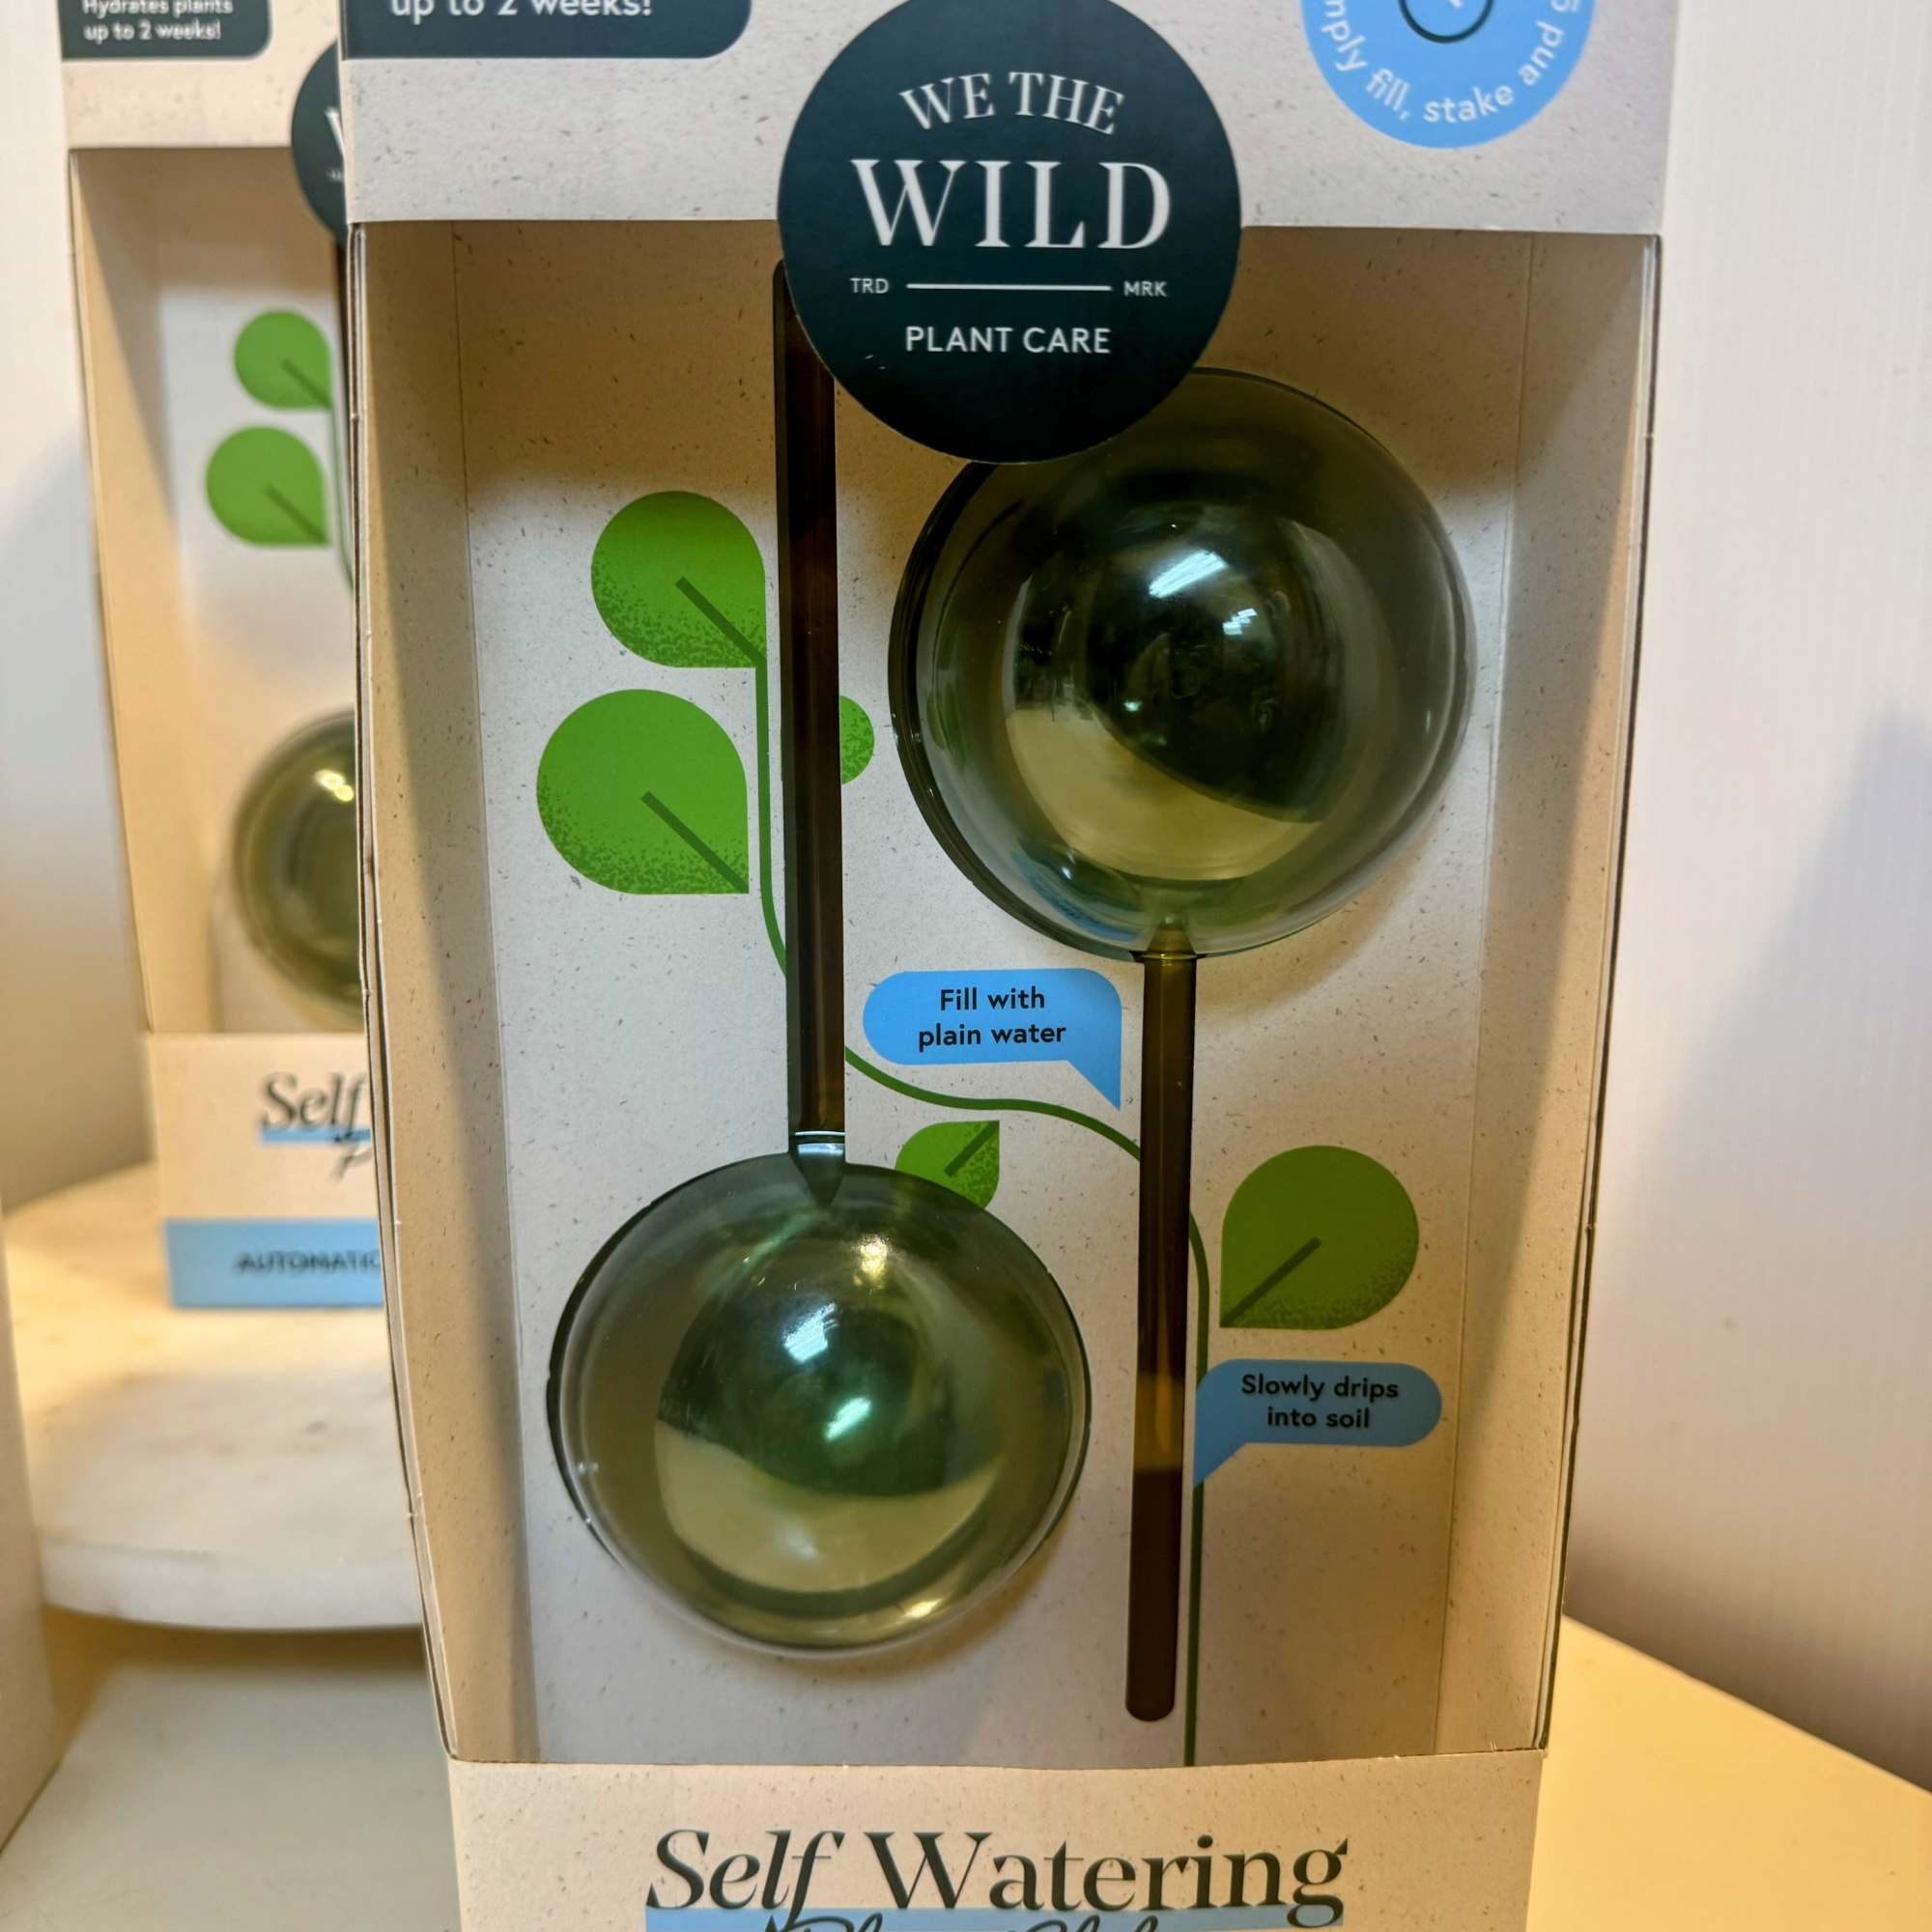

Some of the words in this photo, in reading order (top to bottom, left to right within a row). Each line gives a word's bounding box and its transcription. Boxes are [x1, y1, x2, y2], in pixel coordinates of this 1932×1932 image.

[82, 0, 168, 19] Hydrates
[173, 0, 234, 18] plants
[83, 23, 109, 44] up
[112, 22, 135, 41] to
[139, 19, 152, 40] 2
[155, 19, 221, 41] weeks!
[1365, 69, 1410, 121] fill,
[1422, 87, 1515, 123] stake
[1518, 19, 1564, 86] and
[899, 72, 995, 130] WE
[1009, 71, 1124, 135] THE
[850, 158, 1171, 250] WILD
[850, 277, 890, 295] TRD
[1123, 280, 1168, 298] MRK
[906, 326, 1013, 354] PLANT
[1023, 327, 1111, 355] CARE
[940, 986, 978, 1011] Fill
[987, 985, 1045, 1009] with
[919, 1022, 981, 1052] plain
[991, 1023, 1066, 1044] water
[260, 1071, 368, 1143] Self
[1241, 1374, 1325, 1402] Slowly
[1333, 1376, 1400, 1403] drips
[1267, 1406, 1318, 1428] into
[1325, 1407, 1371, 1429] soil
[645, 1829, 846, 1932] Self
[864, 1830, 1350, 1929] Watering
